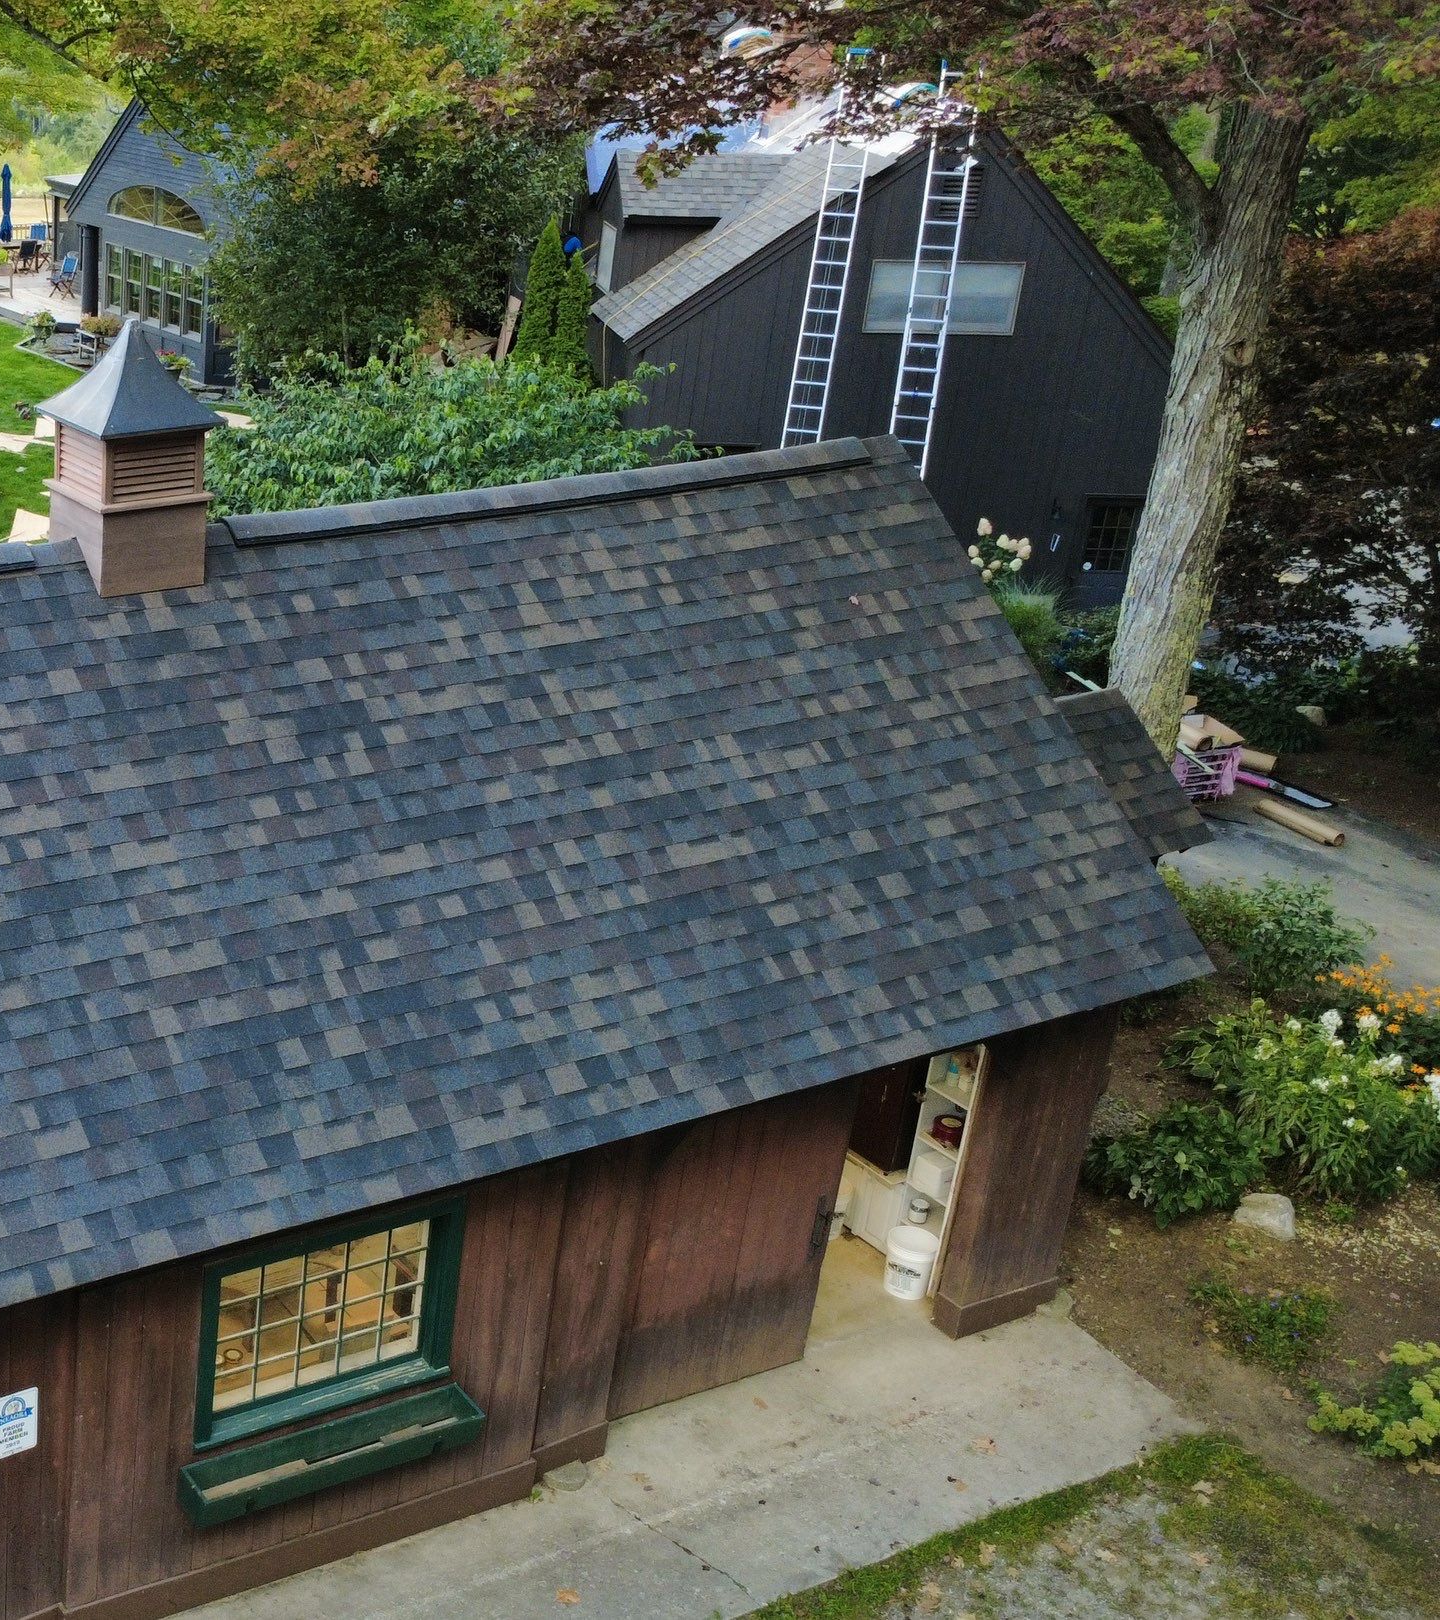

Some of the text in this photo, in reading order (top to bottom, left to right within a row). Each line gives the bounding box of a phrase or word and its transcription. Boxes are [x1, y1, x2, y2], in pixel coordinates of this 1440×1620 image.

[3, 1422, 25, 1432] PROUD
[4, 1428, 23, 1437] FARM
[0, 1431, 28, 1445] MEMBER
